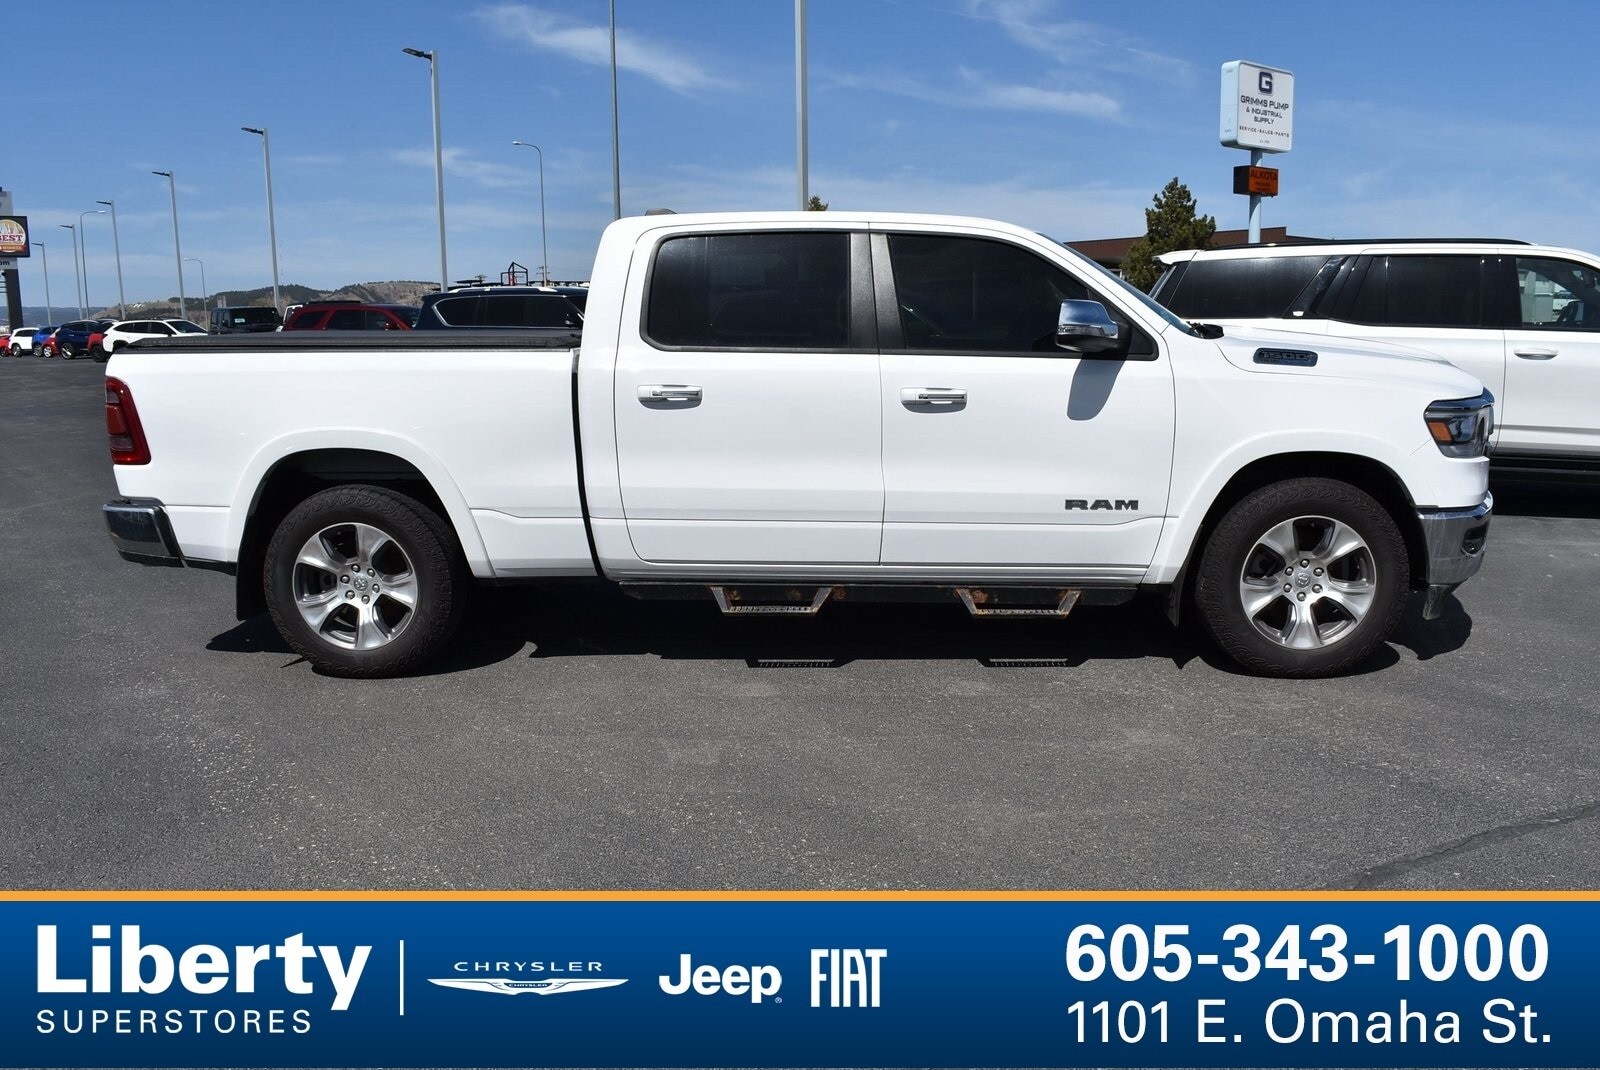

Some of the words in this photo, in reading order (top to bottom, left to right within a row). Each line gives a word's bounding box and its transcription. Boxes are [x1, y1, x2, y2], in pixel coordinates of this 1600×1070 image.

[1259, 71, 1273, 94] G
[1240, 95, 1268, 107] GRIMMS
[1269, 100, 1289, 111] PUMP
[1251, 108, 1283, 118] INDUSTRIAL
[1254, 116, 1275, 124] SUPPLY
[1261, 350, 1309, 361] 1500
[1065, 499, 1138, 510] RAM
